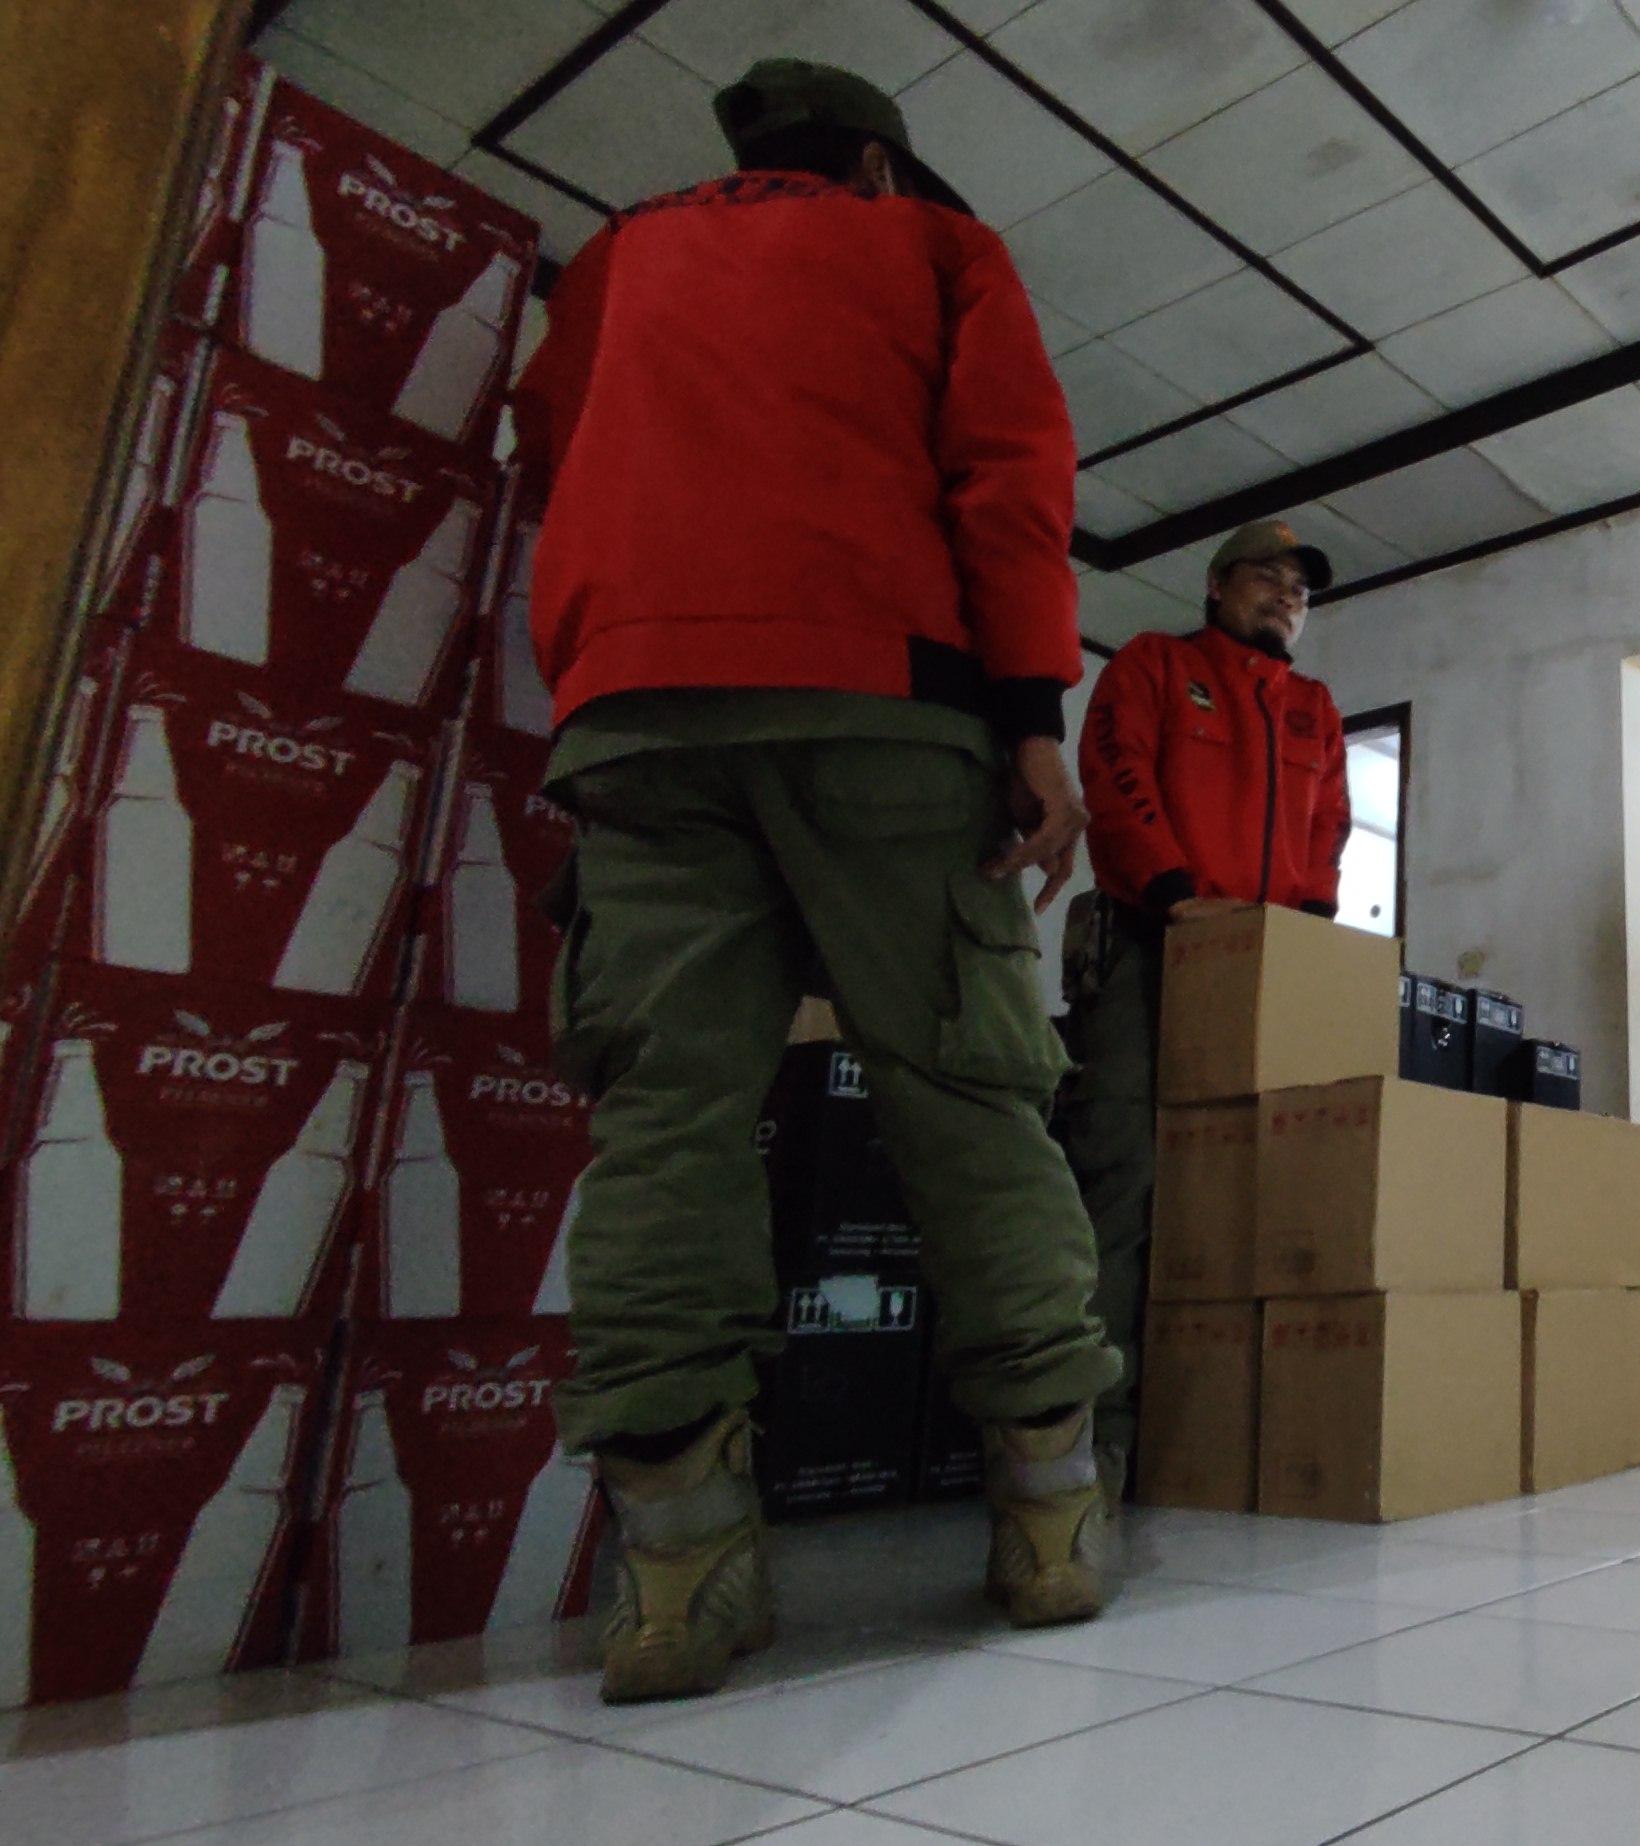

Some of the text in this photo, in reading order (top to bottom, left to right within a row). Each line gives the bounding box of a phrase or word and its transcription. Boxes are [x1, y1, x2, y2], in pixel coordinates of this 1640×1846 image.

[337, 173, 467, 252] PROST
[286, 436, 424, 504] PROST
[207, 721, 355, 776] PROST
[136, 1046, 299, 1087] PROST
[50, 1392, 230, 1434] PROST
[420, 1377, 552, 1414] PROST
